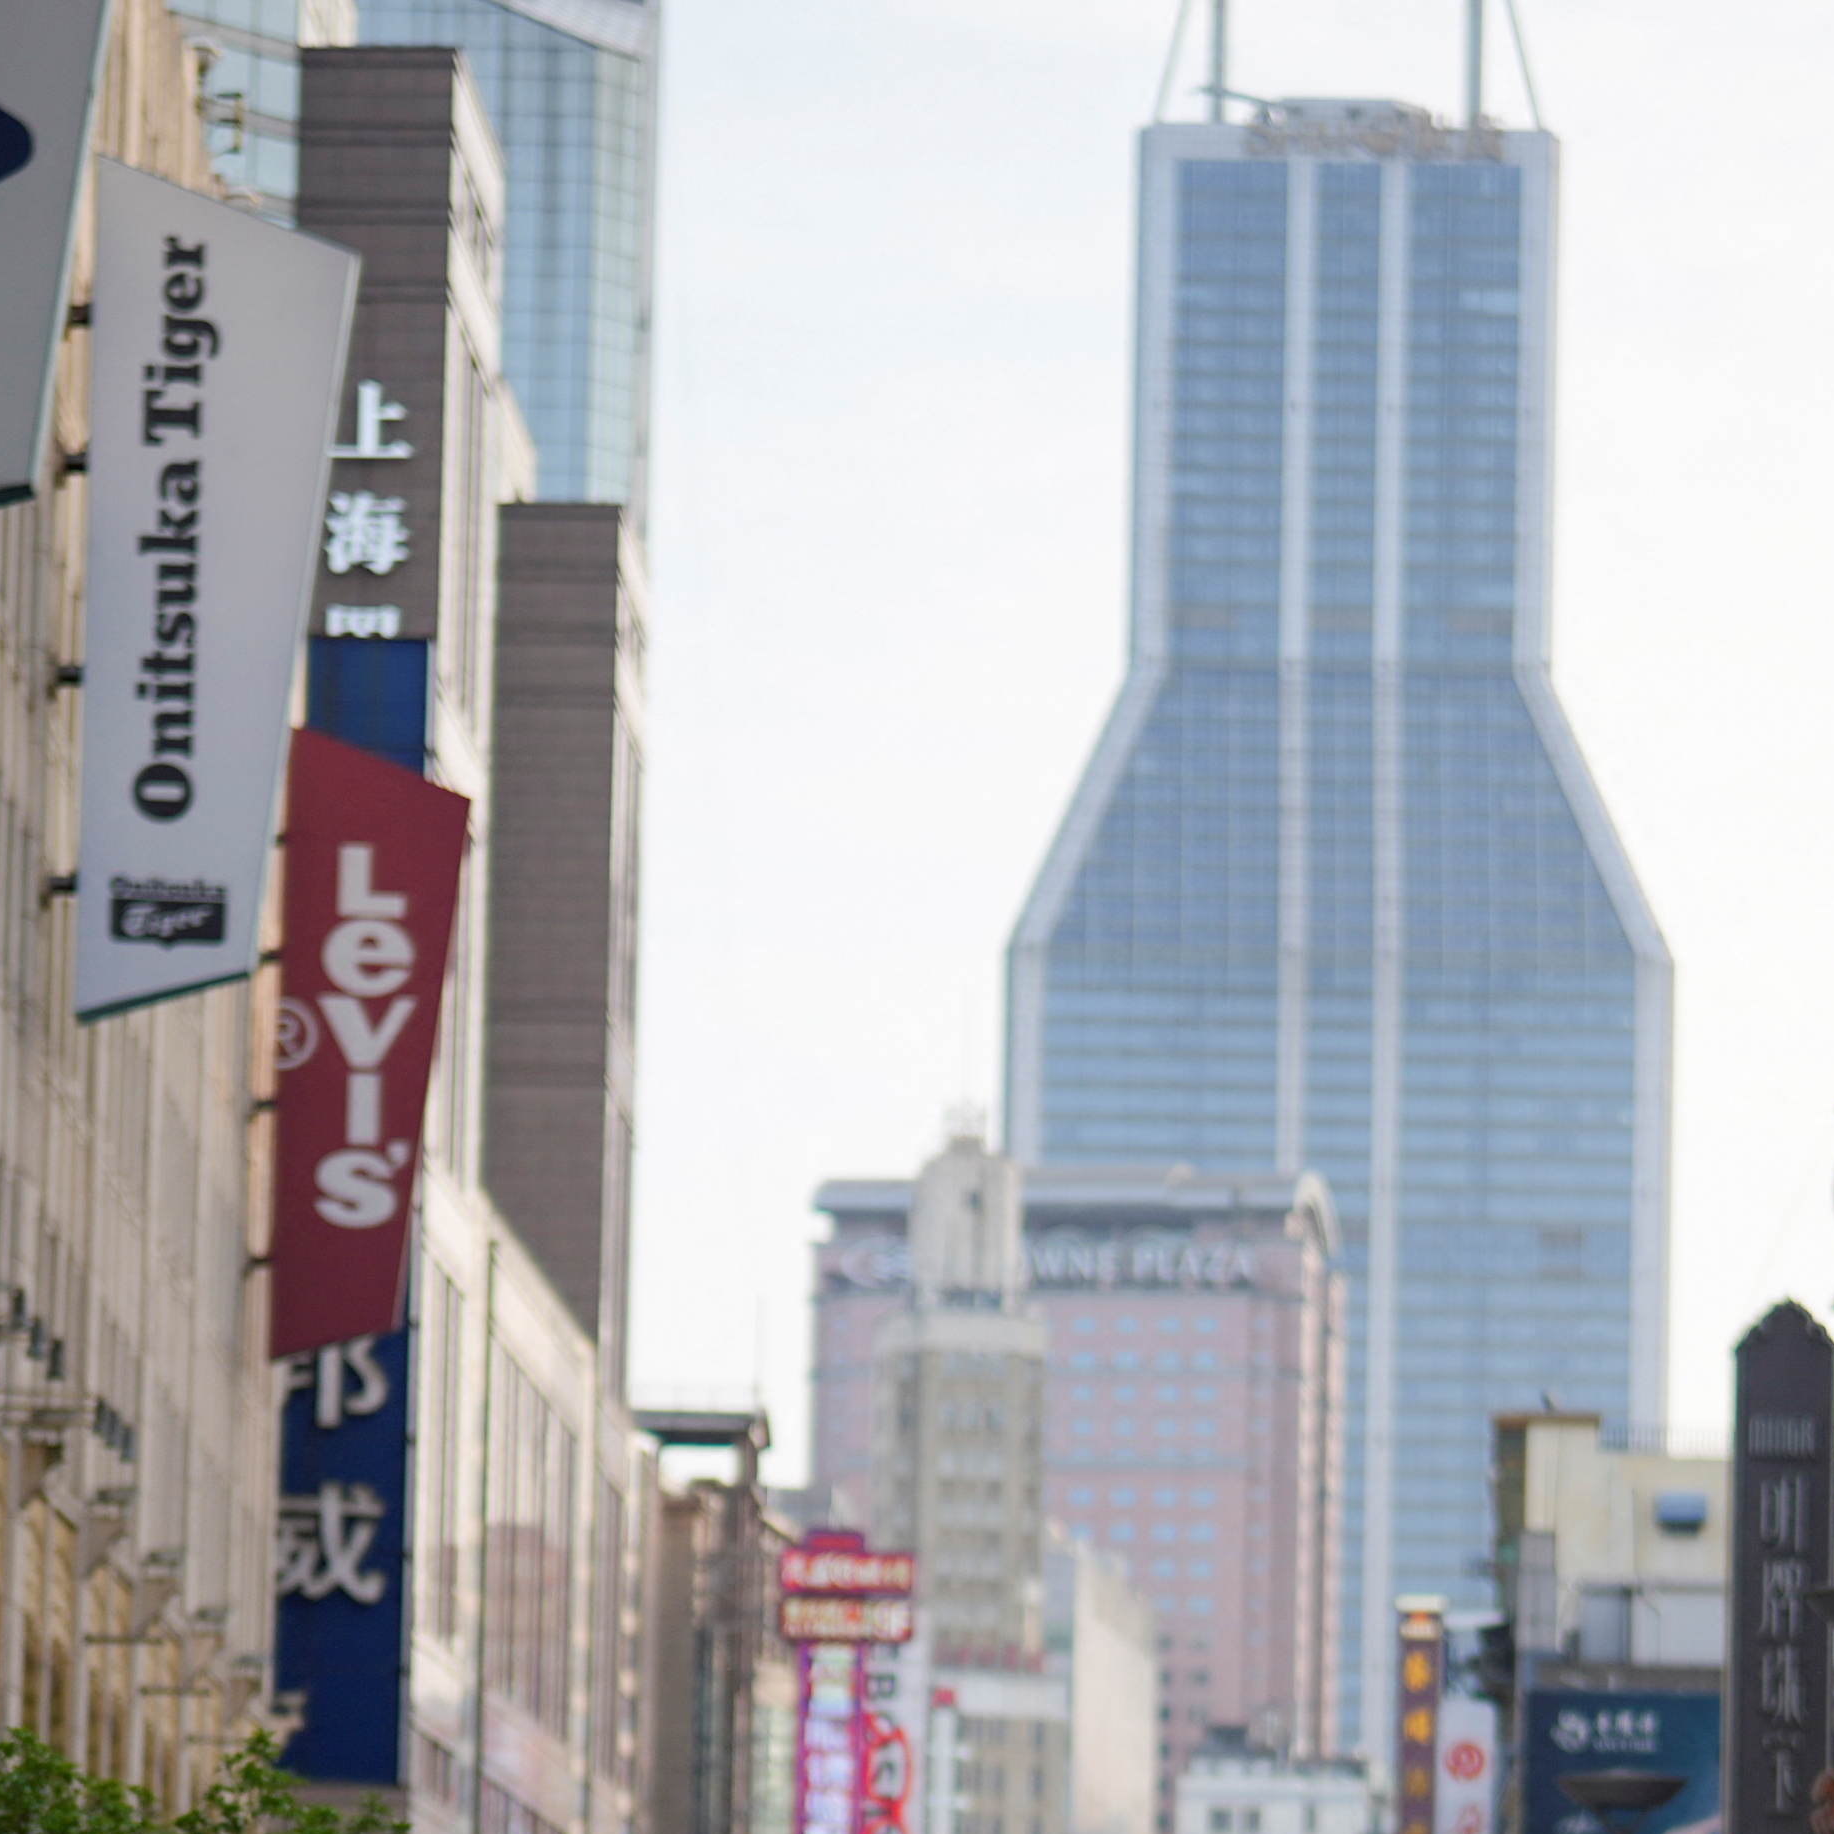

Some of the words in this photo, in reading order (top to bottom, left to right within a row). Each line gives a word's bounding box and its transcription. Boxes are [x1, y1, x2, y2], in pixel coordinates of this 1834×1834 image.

[143, 236, 220, 448] Tiger
[132, 455, 202, 823] Onitsuka
[1131, 1244, 1256, 1284] PLAZA
